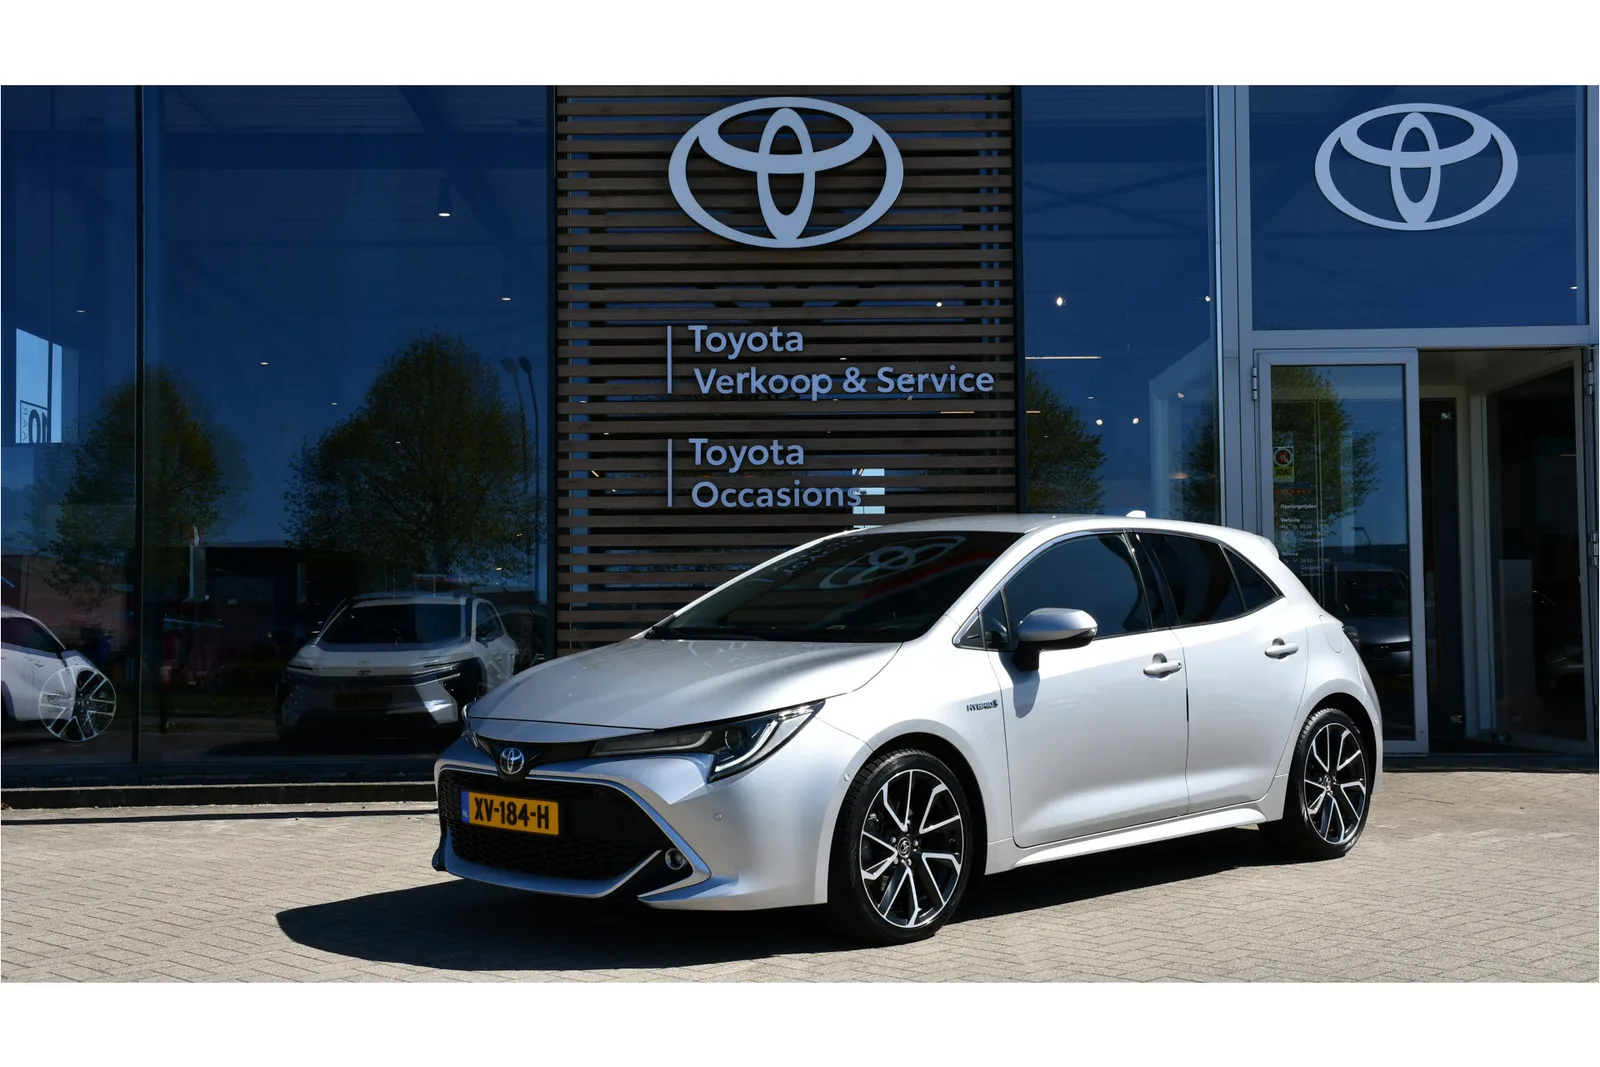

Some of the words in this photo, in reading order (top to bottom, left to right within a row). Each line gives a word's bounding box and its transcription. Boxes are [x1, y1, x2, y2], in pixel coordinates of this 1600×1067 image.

[688, 325, 804, 360] Toyota
[693, 366, 833, 402] Verkoop
[842, 367, 867, 393] &
[876, 365, 995, 393] Service
[688, 438, 804, 473] Toyota
[691, 479, 862, 508] Occasions
[474, 797, 549, 830] XV-184-H
